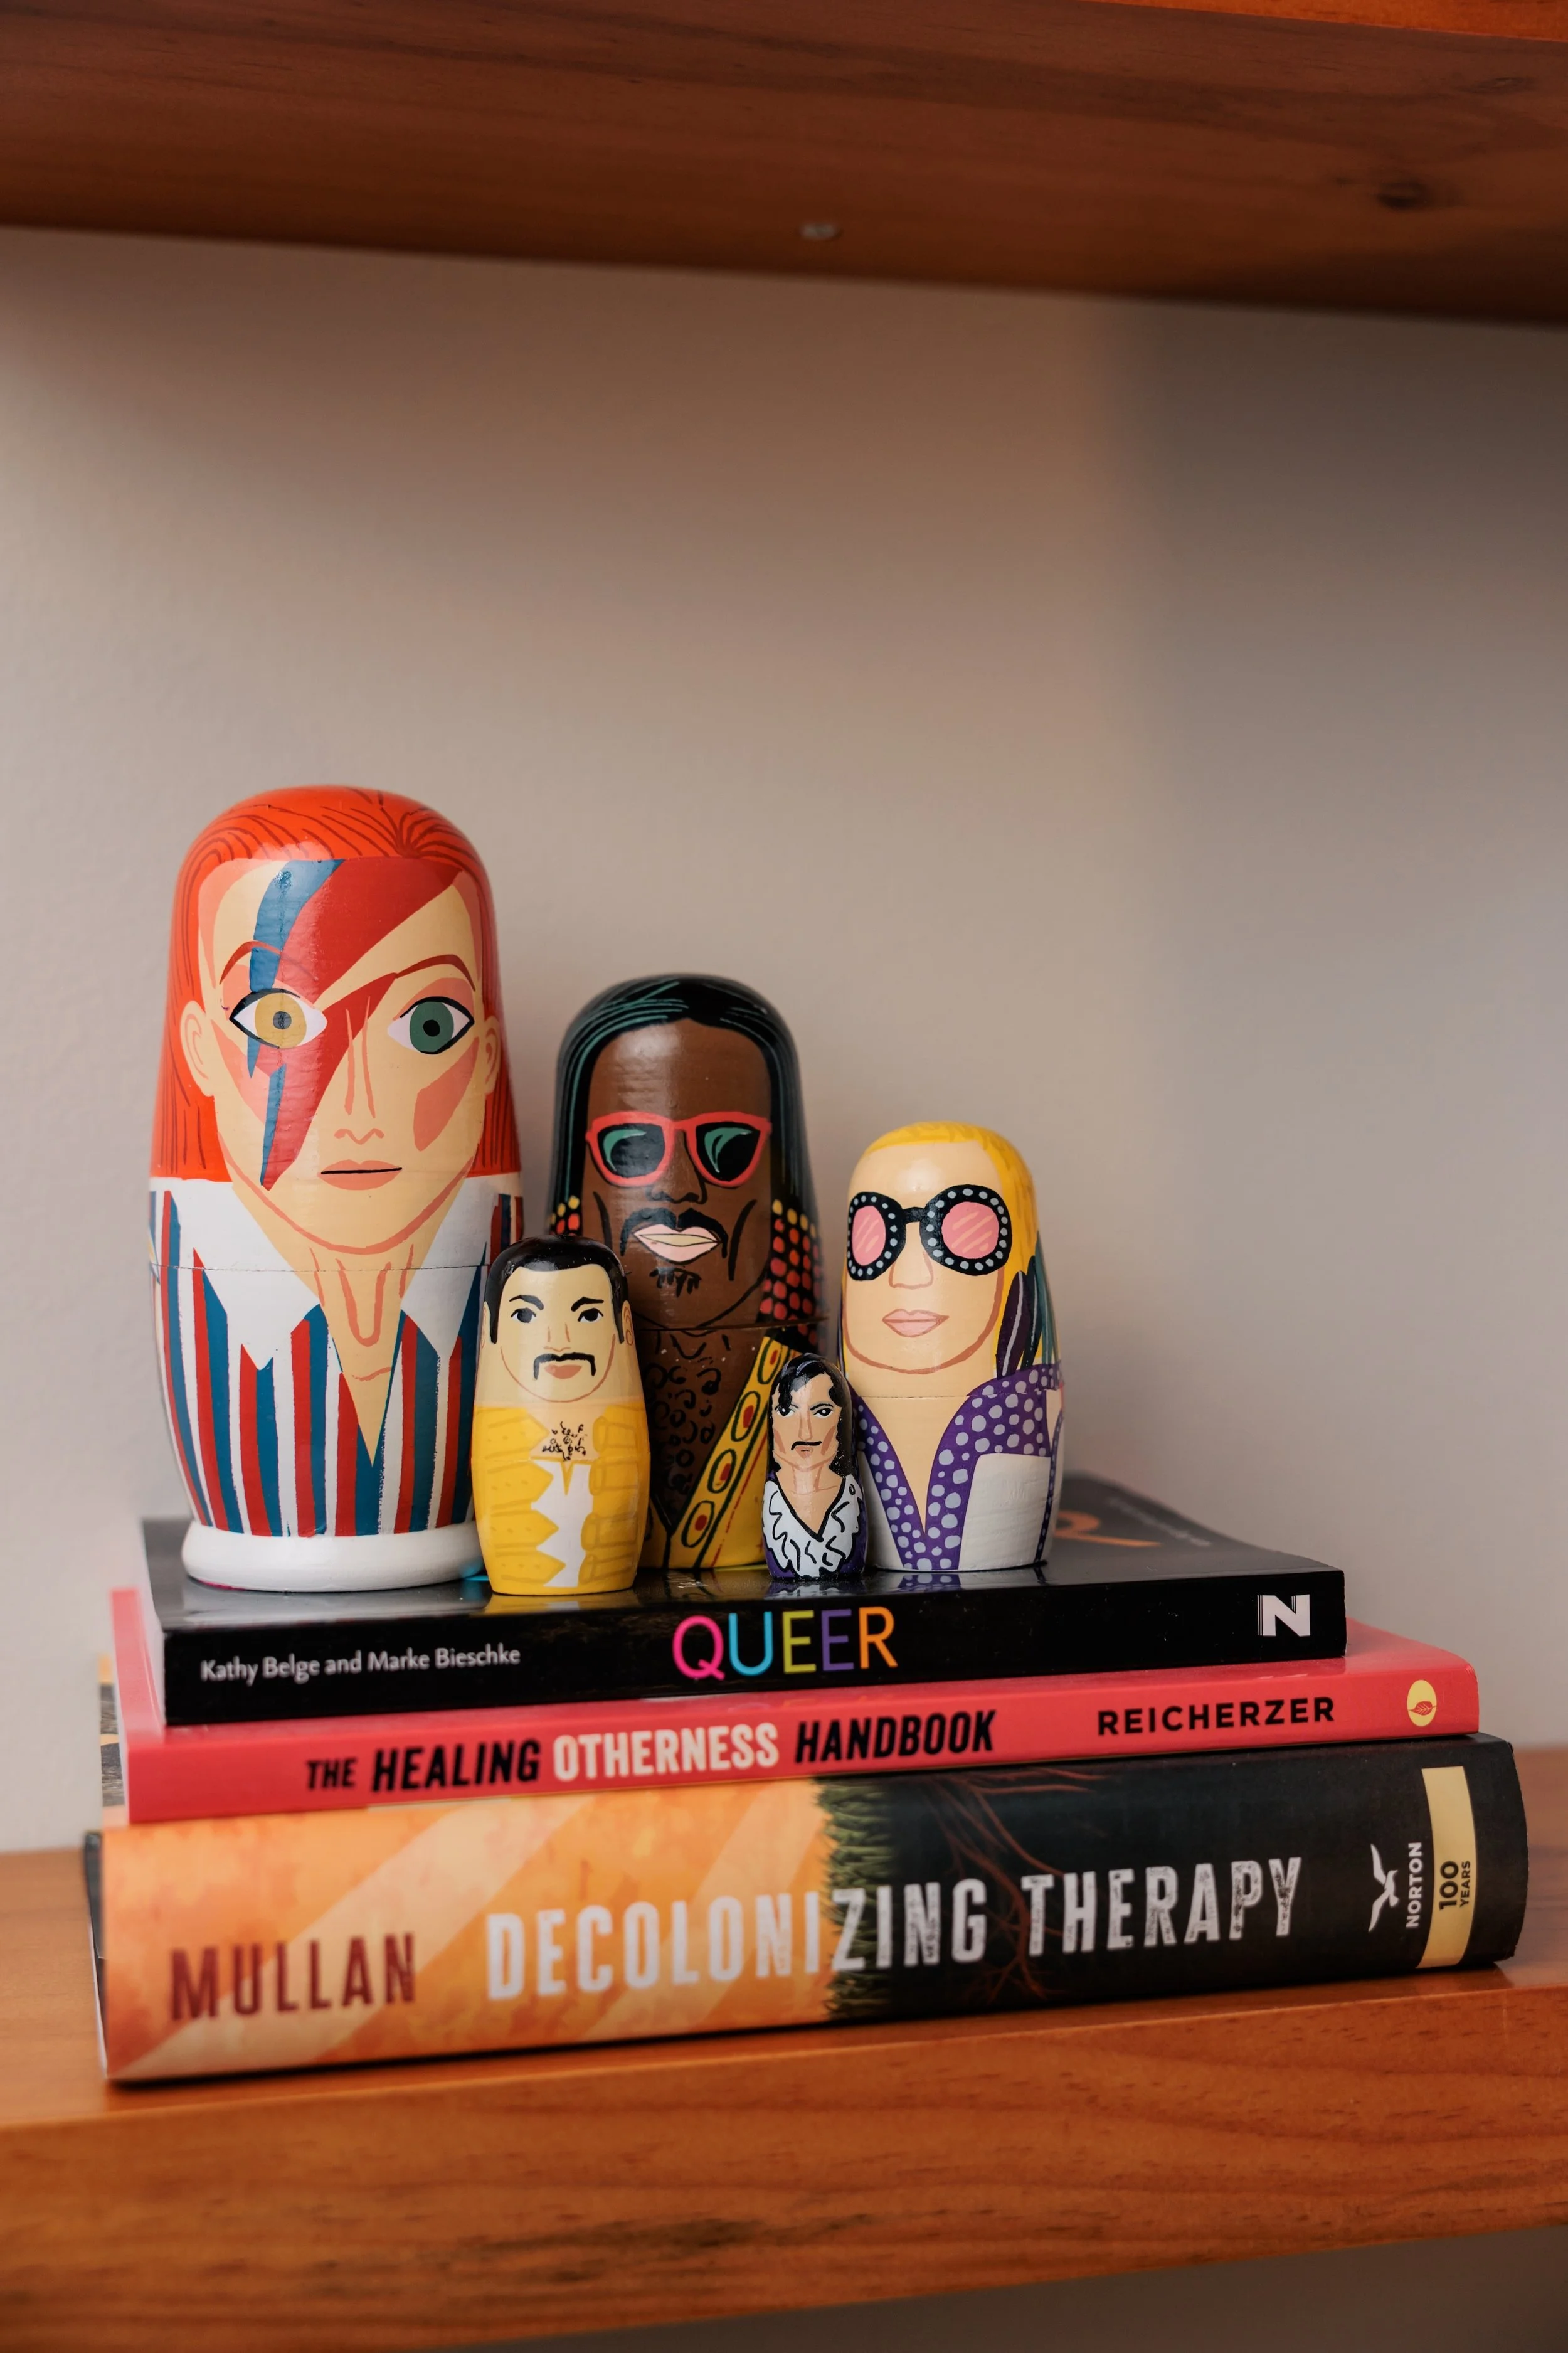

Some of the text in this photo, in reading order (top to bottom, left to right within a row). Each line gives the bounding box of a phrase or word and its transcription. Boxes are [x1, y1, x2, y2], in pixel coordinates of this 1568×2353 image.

[201, 1642, 521, 1686] Kathy Belge and Marke Bieschke
[672, 1605, 898, 1680] QUEER
[1098, 1696, 1335, 1736] REICHERZER
[306, 1710, 997, 1792] THE HEALING OTHERNESS HANDBOOK
[1406, 1842, 1422, 1928] NORTON
[1439, 1861, 1459, 1911] 100
[1459, 1860, 1471, 1908] YEARS
[170, 1857, 1303, 2021] MULLAN DECOLONIZING THERAPY
